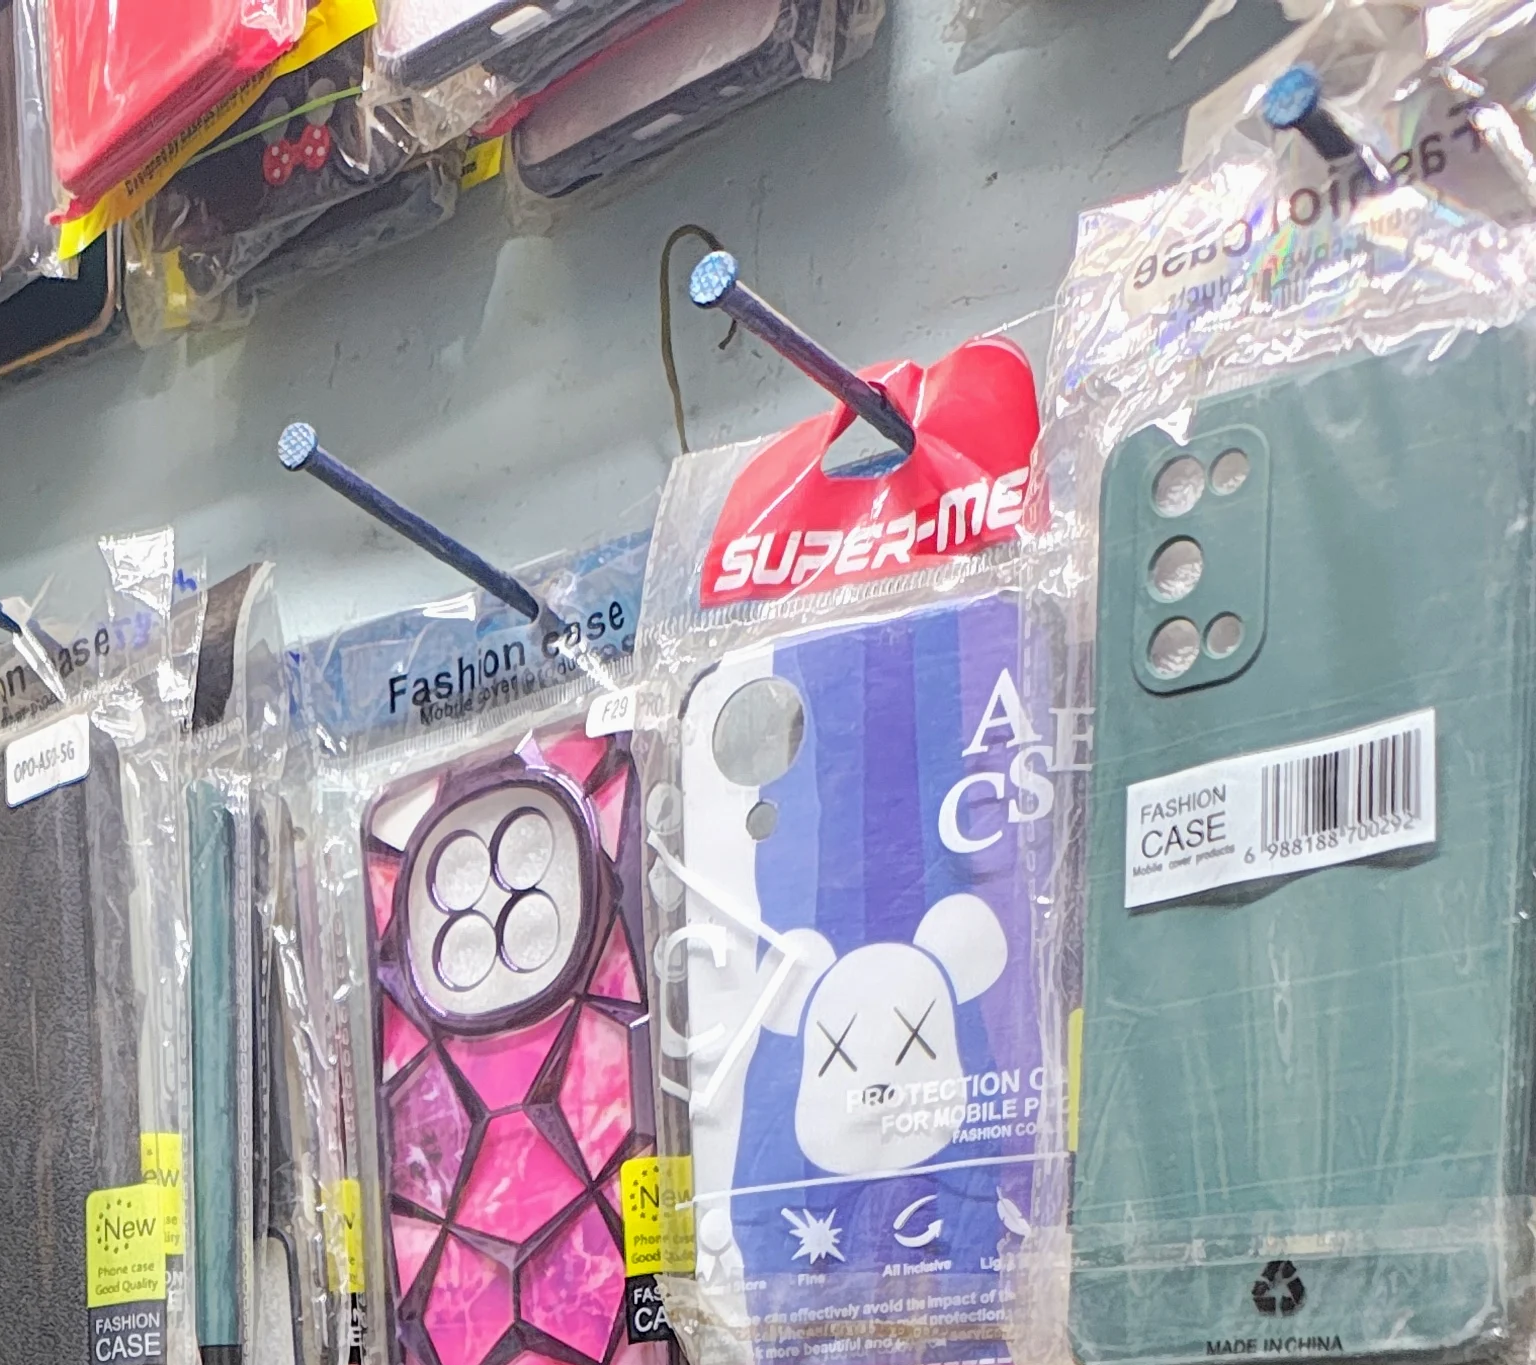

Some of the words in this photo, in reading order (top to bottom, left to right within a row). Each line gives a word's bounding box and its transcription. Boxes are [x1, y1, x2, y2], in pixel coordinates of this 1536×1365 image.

[713, 466, 1030, 594] SUPER-ME
[52, 628, 110, 679] ase
[389, 640, 526, 714] Fashion
[541, 601, 625, 659] case
[1140, 784, 1227, 825] FASHION
[1140, 811, 1227, 858] CASE
[1244, 846, 1256, 864] 6
[846, 1067, 1020, 1113] PROTECTION
[881, 1110, 928, 1134] FOR
[933, 1099, 1017, 1127] MOBILE
[952, 1125, 1012, 1144] FASHION
[104, 1215, 157, 1242] New
[98, 1266, 130, 1277] Phone
[131, 1262, 155, 1272] case
[96, 1282, 120, 1296] Good
[122, 1277, 158, 1292] Quality
[95, 1312, 161, 1335] FASHION
[95, 1332, 161, 1362] CASE
[1206, 1338, 1258, 1356] MADE
[1285, 1334, 1344, 1352] CHINA
